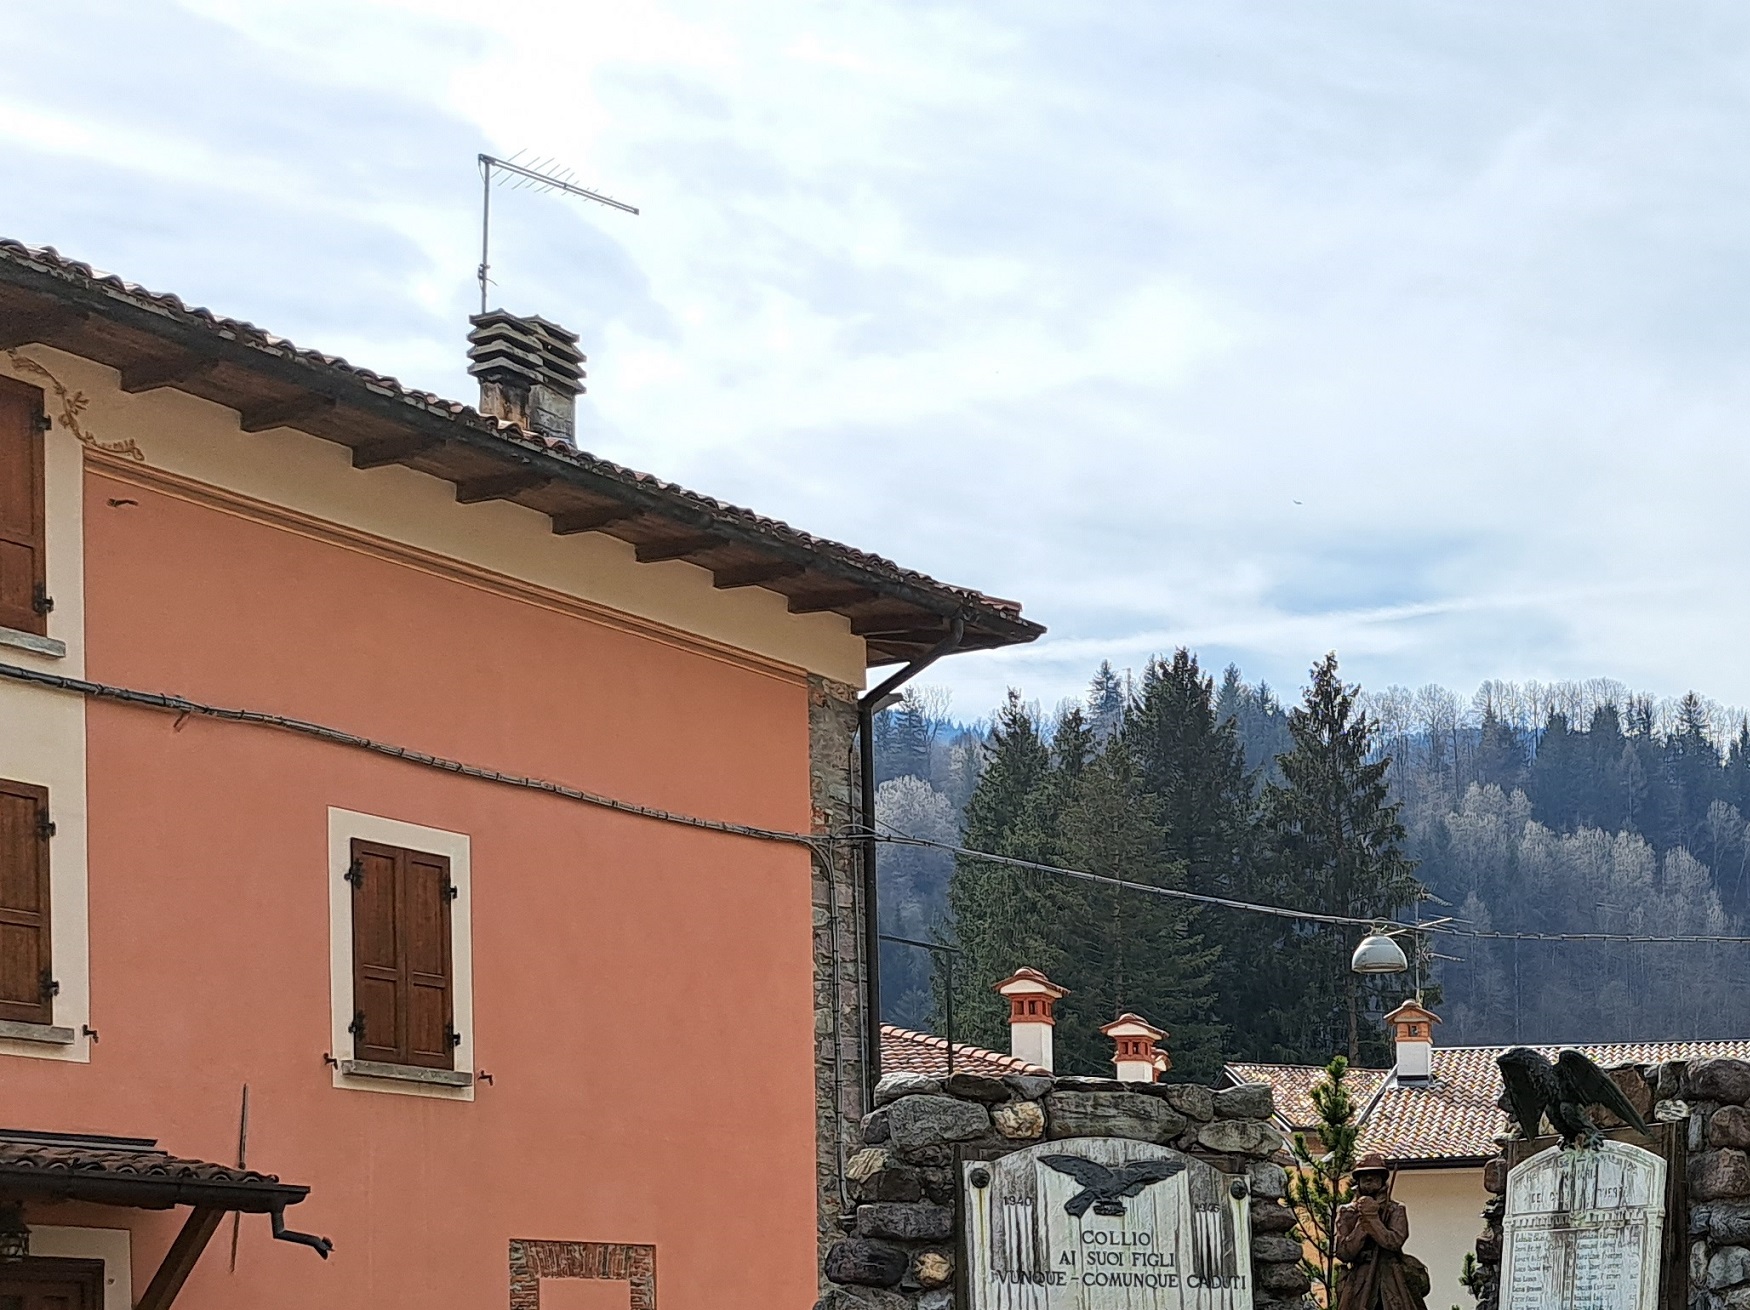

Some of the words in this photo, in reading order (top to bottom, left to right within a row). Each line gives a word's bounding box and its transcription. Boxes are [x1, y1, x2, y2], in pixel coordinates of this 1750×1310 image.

[1003, 1196, 1031, 1206] 1940
[1082, 1230, 1150, 1246] COLLIO
[1059, 1251, 1076, 1265] AI
[1087, 1251, 1123, 1266] SUOI
[1132, 1252, 1175, 1267] FIGLI
[990, 1271, 1067, 1287] VUNQUE
[1082, 1273, 1178, 1289] COMUNQUE
[1187, 1274, 1246, 1290] CADUTI
